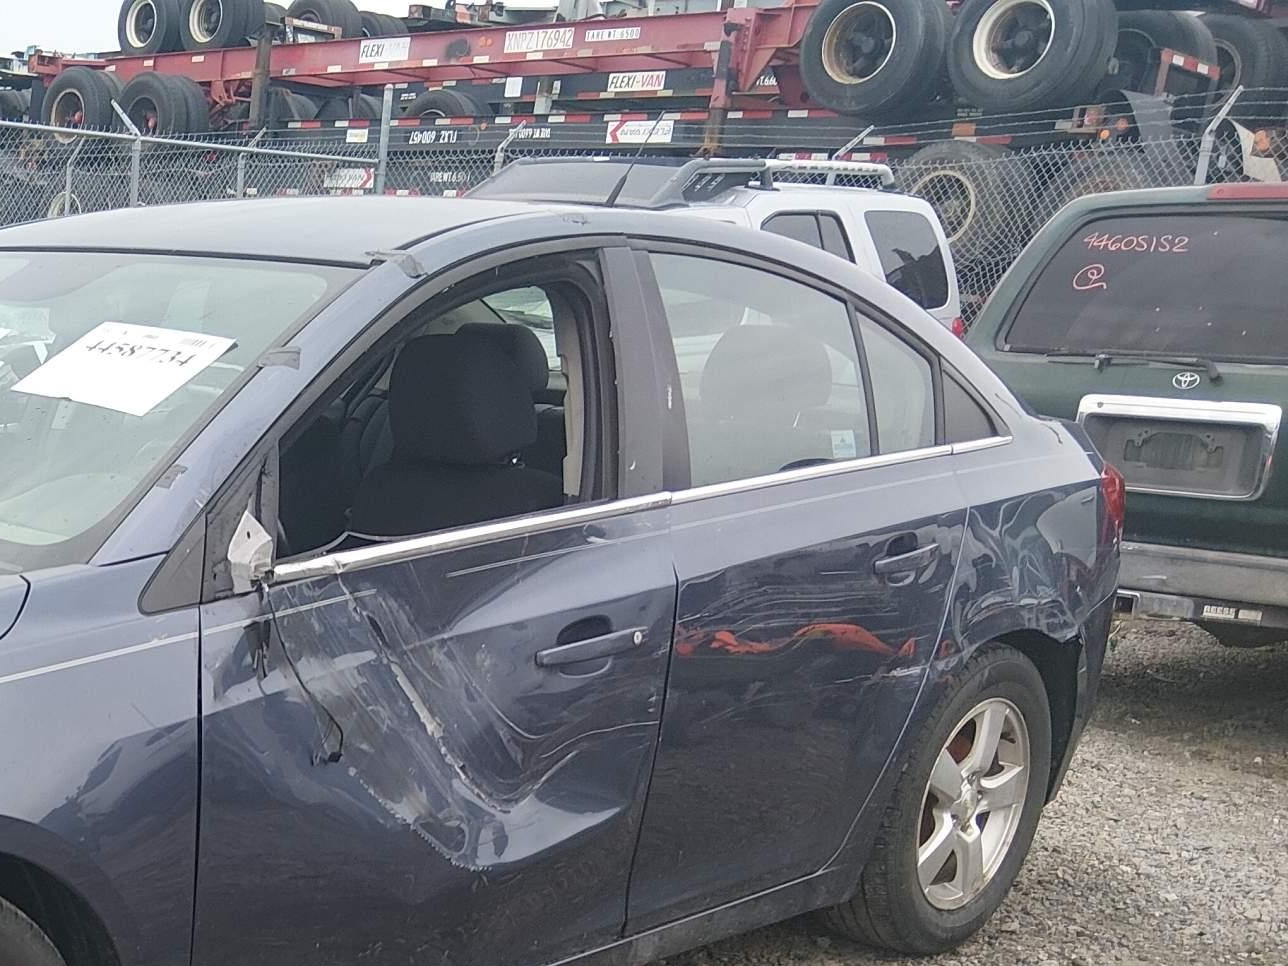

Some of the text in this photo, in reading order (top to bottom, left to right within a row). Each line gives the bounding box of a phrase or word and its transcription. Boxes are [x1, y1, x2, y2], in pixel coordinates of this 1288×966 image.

[360, 43, 385, 58] FLEXI
[609, 73, 664, 89] FLEXI-VAN
[409, 130, 457, 144] FLXZ 600457
